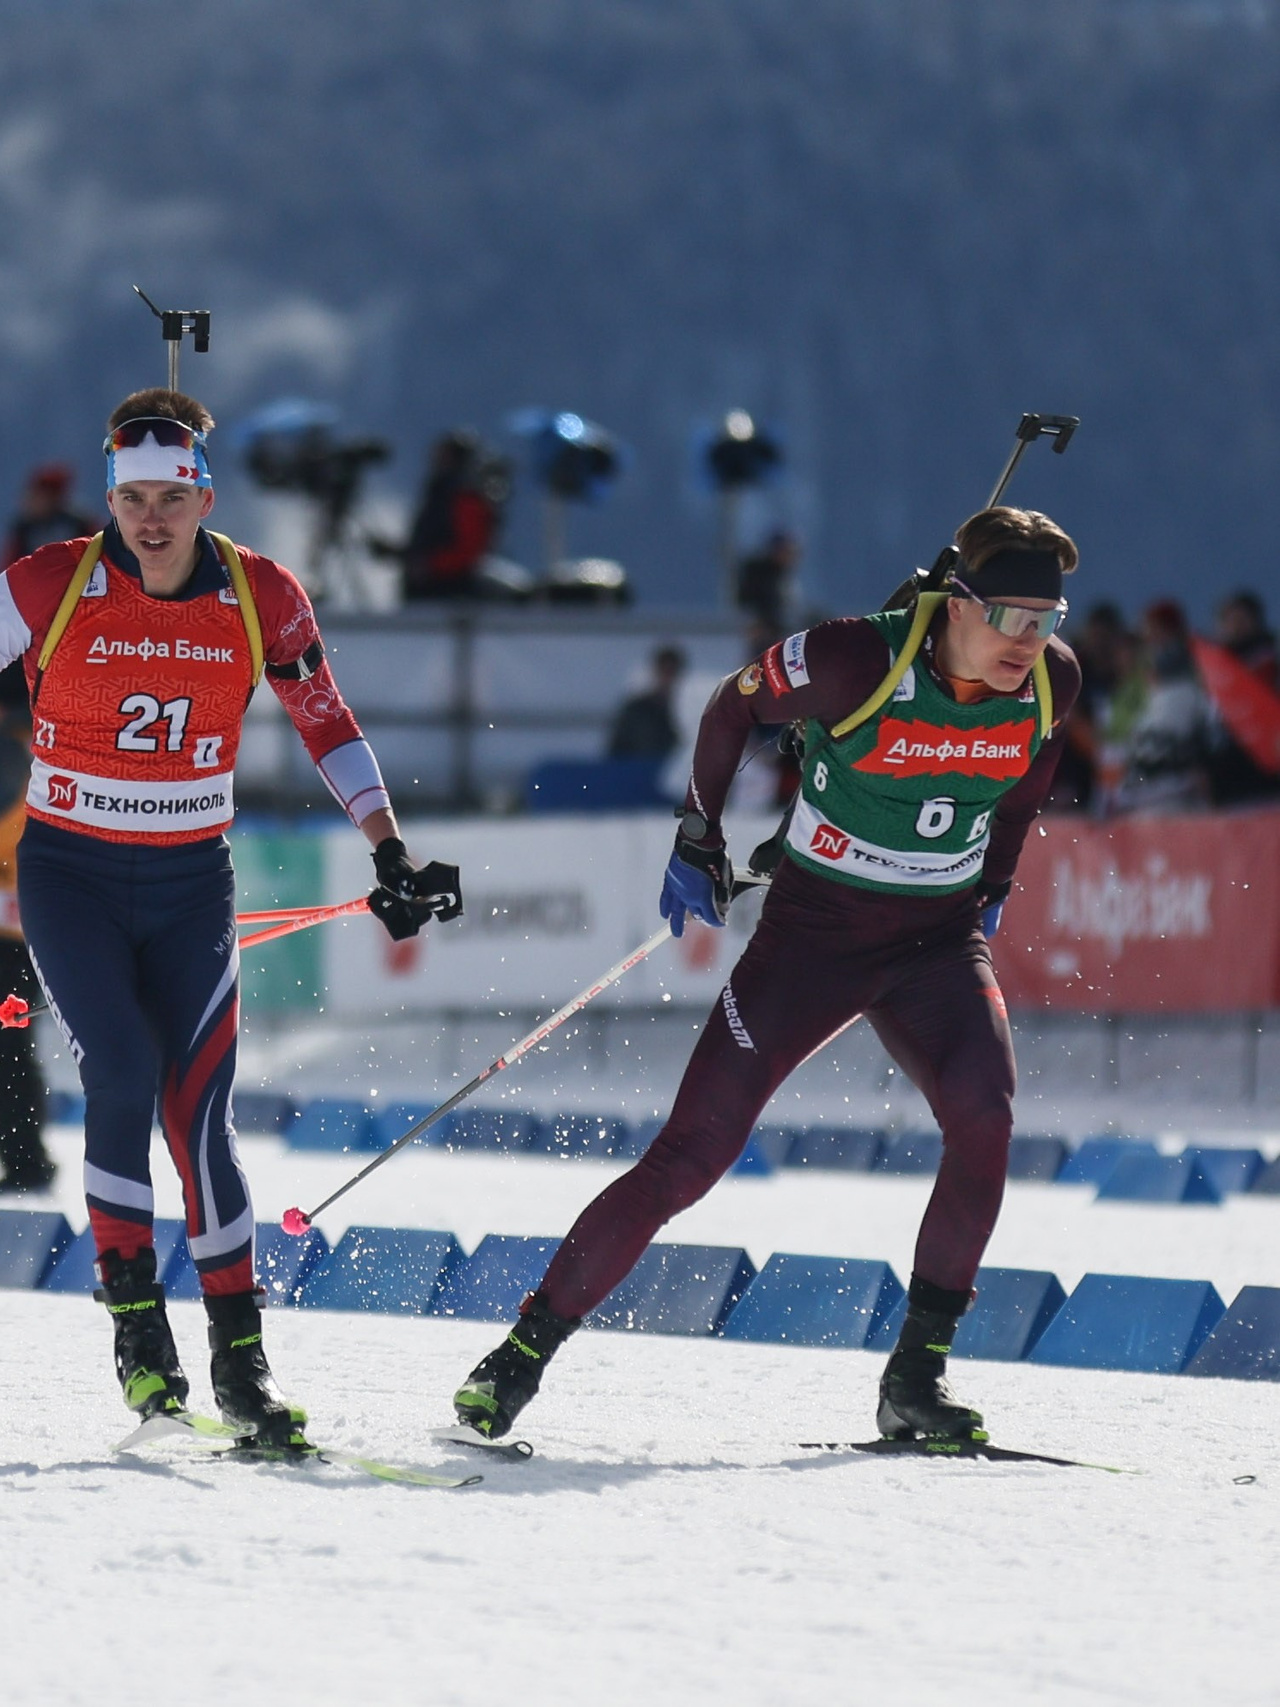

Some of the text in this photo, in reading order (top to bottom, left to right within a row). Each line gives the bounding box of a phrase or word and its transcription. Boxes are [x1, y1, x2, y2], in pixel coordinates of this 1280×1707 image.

[86, 636, 234, 663] Альфа Банк
[36, 718, 55, 749] 21
[115, 692, 192, 753] 21
[883, 738, 1021, 764] Альфа Банк
[814, 762, 828, 792] 6
[81, 791, 225, 815] ТЕХНОНИКОЛЬ
[915, 796, 956, 839] 6
[108, 1299, 156, 1314] SCHER
